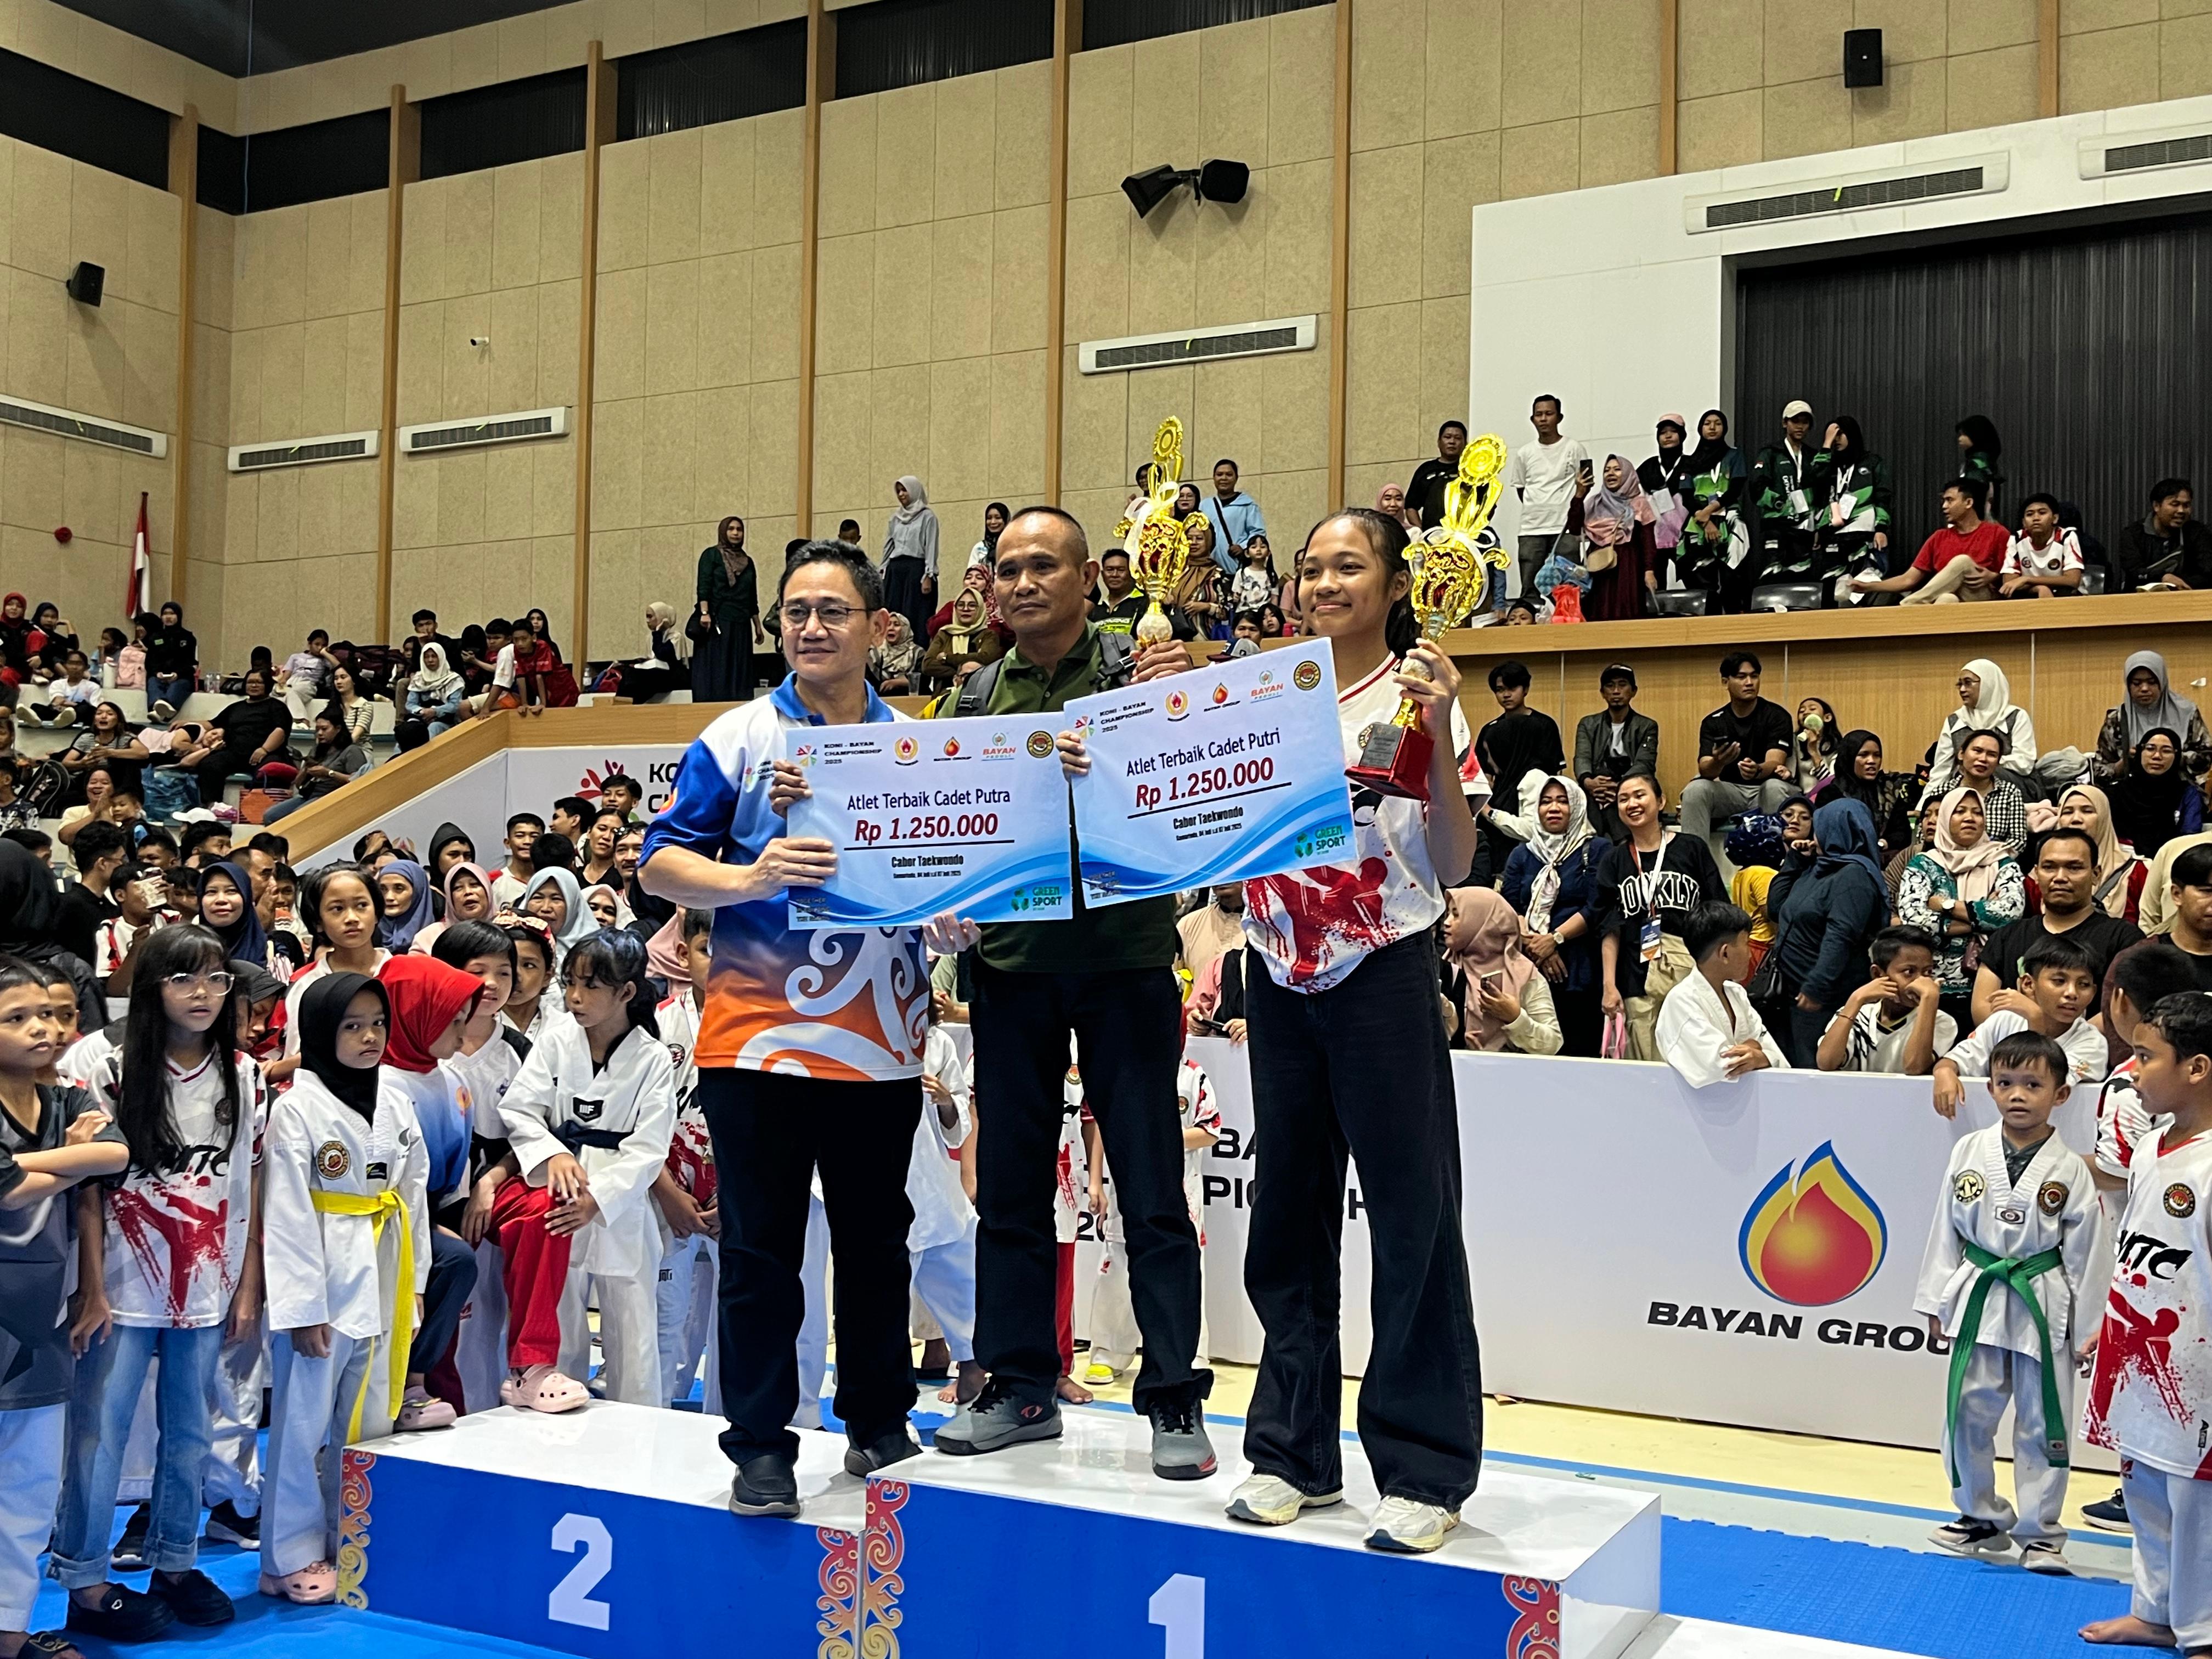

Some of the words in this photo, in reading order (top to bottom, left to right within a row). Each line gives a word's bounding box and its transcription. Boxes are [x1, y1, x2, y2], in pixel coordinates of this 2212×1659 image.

[1251, 684, 1283, 697] BAYAN
[1123, 702, 1146, 710] BAYAN
[1101, 708, 1154, 725] CHAMPIONSHIP
[983, 747, 1016, 755] BAYAN
[1127, 759, 1156, 777] Atlet
[1159, 747, 1205, 769] Terbaik
[1209, 736, 1245, 759] Cadet
[1249, 727, 1280, 747] Putri
[1136, 784, 1161, 809] Rp
[1169, 757, 1274, 802] 1.250.000
[847, 792, 879, 810] Atlet
[882, 791, 930, 808] Terbaik
[934, 789, 971, 806] Cadet
[976, 788, 1011, 804] Putra
[1173, 816, 1197, 830] Cabor
[1198, 806, 1243, 825] Taekwondo
[855, 820, 881, 845] Rp
[890, 813, 998, 840] 1.250.000
[1315, 825, 1342, 839] GREEN
[1316, 836, 1345, 850] SPORT
[891, 856, 916, 867] Cabor
[917, 854, 963, 866] Taekwondo
[1032, 886, 1059, 896] GREEN
[1032, 896, 1062, 906] SPORT
[1647, 1301, 1802, 1339] BAYAN
[1818, 1319, 1950, 1355] GROU
[548, 1513, 613, 1631] 2
[1148, 1572, 1206, 1659] 1
